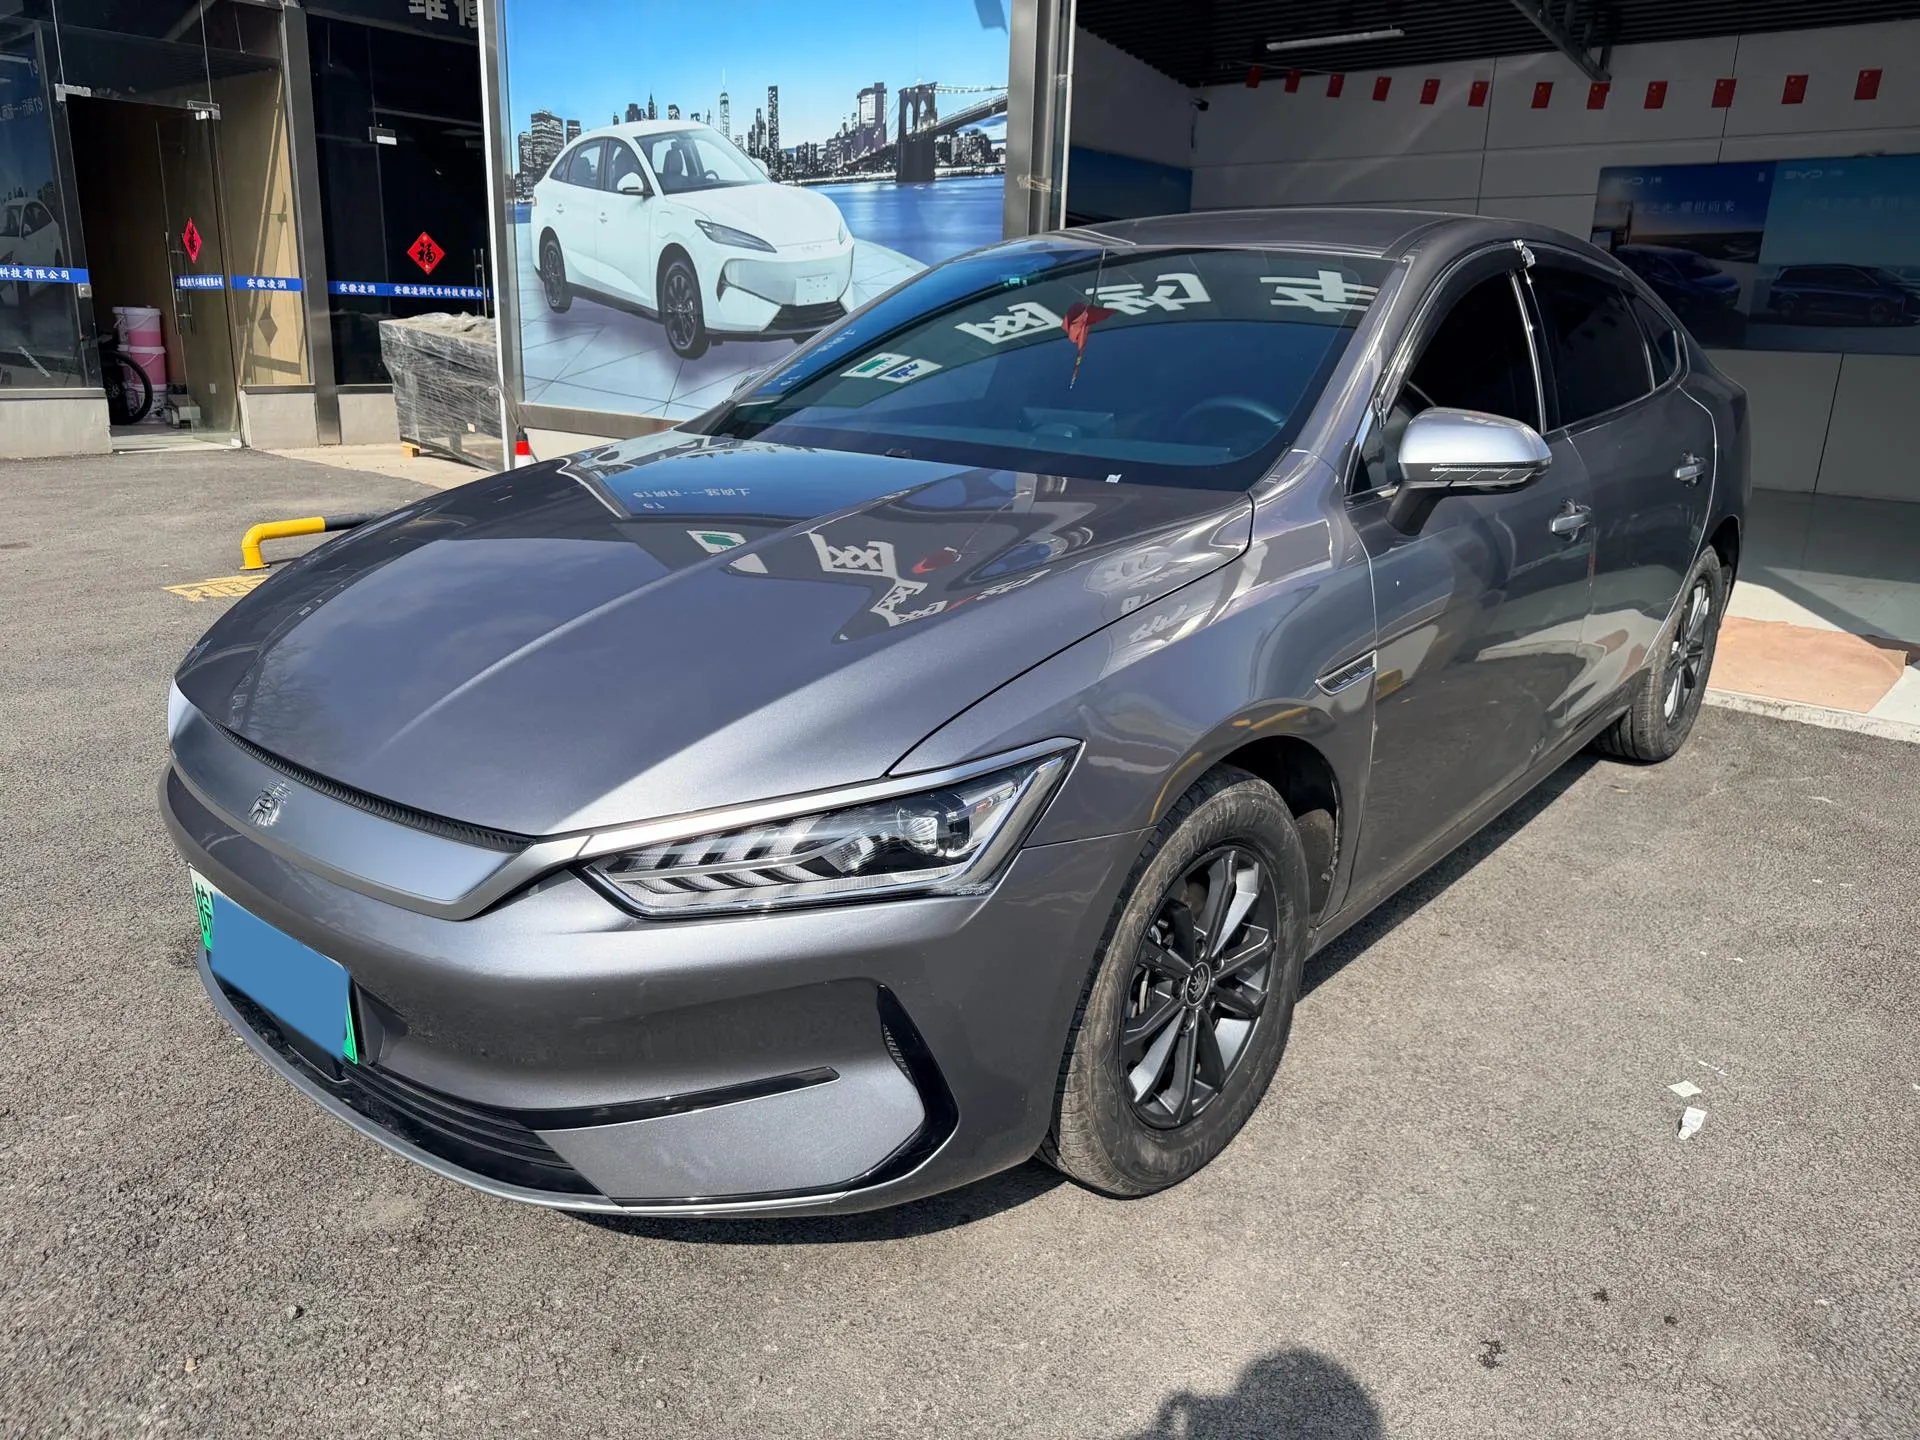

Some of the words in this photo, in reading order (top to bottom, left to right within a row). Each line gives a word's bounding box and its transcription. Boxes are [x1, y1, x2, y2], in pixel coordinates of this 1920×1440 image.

[417, 242, 437, 264] 福
[0, 267, 70, 280] 科技有限公司
